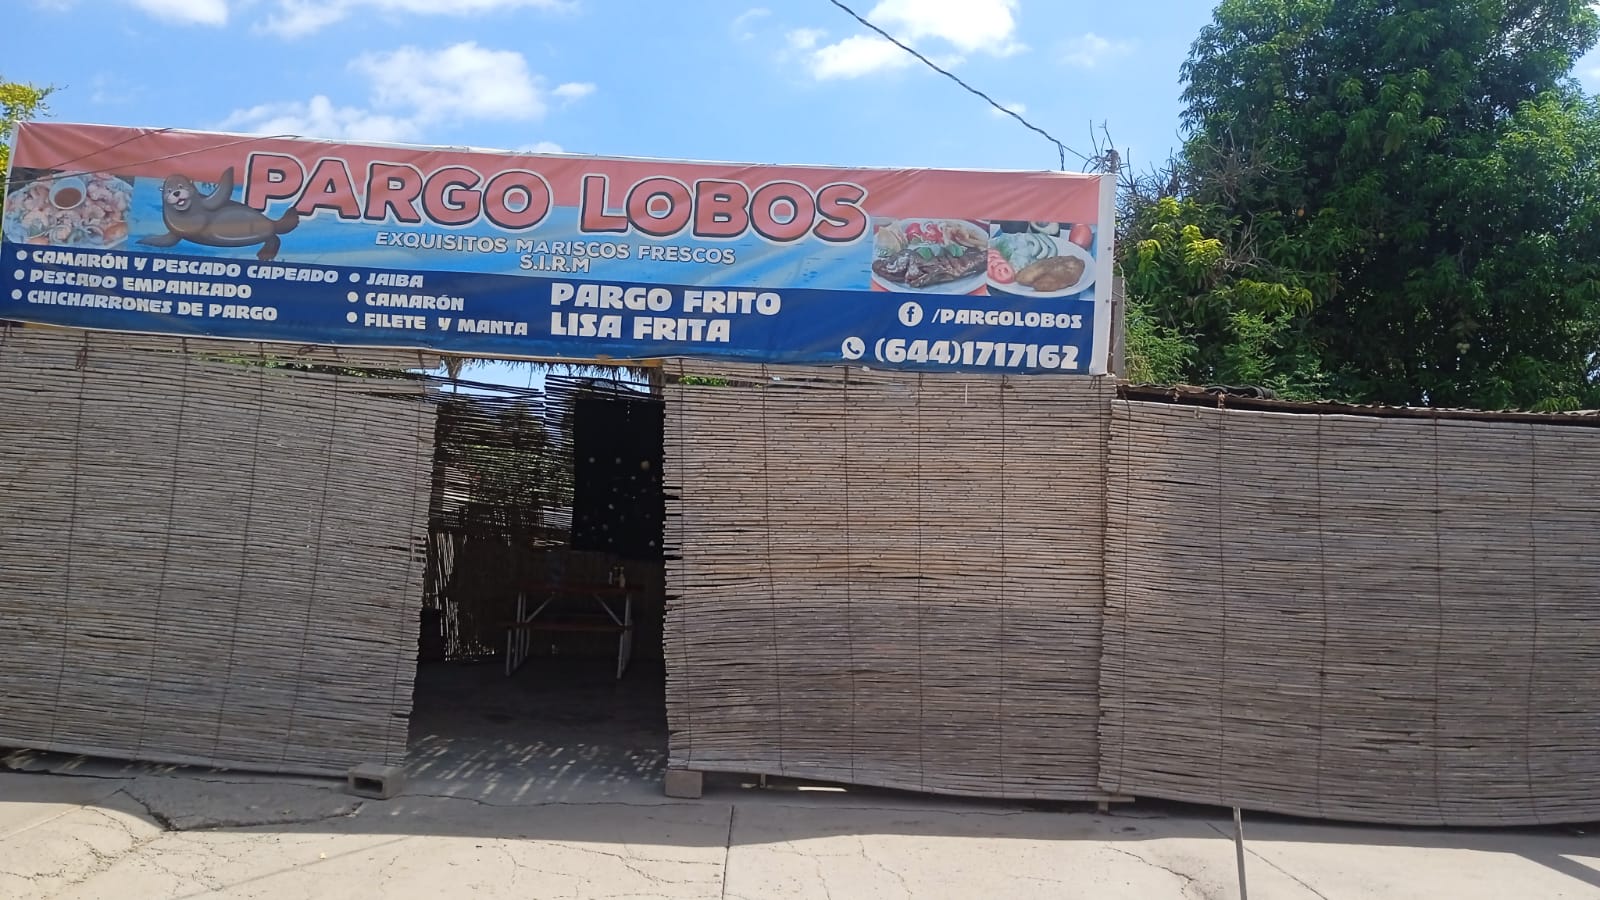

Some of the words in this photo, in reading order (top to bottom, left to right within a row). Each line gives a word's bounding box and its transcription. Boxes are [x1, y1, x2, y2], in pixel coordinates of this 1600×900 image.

[244, 152, 552, 229] PARGO
[579, 174, 869, 244] LOBOS
[375, 231, 507, 254] EXQUISITOS
[515, 239, 630, 259] MARISCOS
[638, 244, 736, 265] FRESCOS
[33, 249, 128, 270] CAMARÓN
[152, 258, 241, 278] PESCADO
[247, 264, 339, 283] CAPEADO
[366, 272, 424, 288] JAIBA
[30, 269, 116, 289] PESCADO
[122, 277, 252, 298] EMPANIZADO
[550, 282, 672, 312] PARGO
[684, 289, 782, 316] FRITO
[27, 289, 172, 313] CHICHARRONES
[177, 301, 203, 316] DE
[208, 304, 278, 321] PARGO
[365, 290, 465, 311] CAMARÓN
[364, 314, 426, 330] FILETE
[457, 319, 528, 336] MANTA
[550, 313, 622, 338] LISA
[632, 316, 730, 343] FRITA
[932, 308, 1082, 329] /PARGOLOBOS
[874, 337, 1079, 370] (644)1717162
